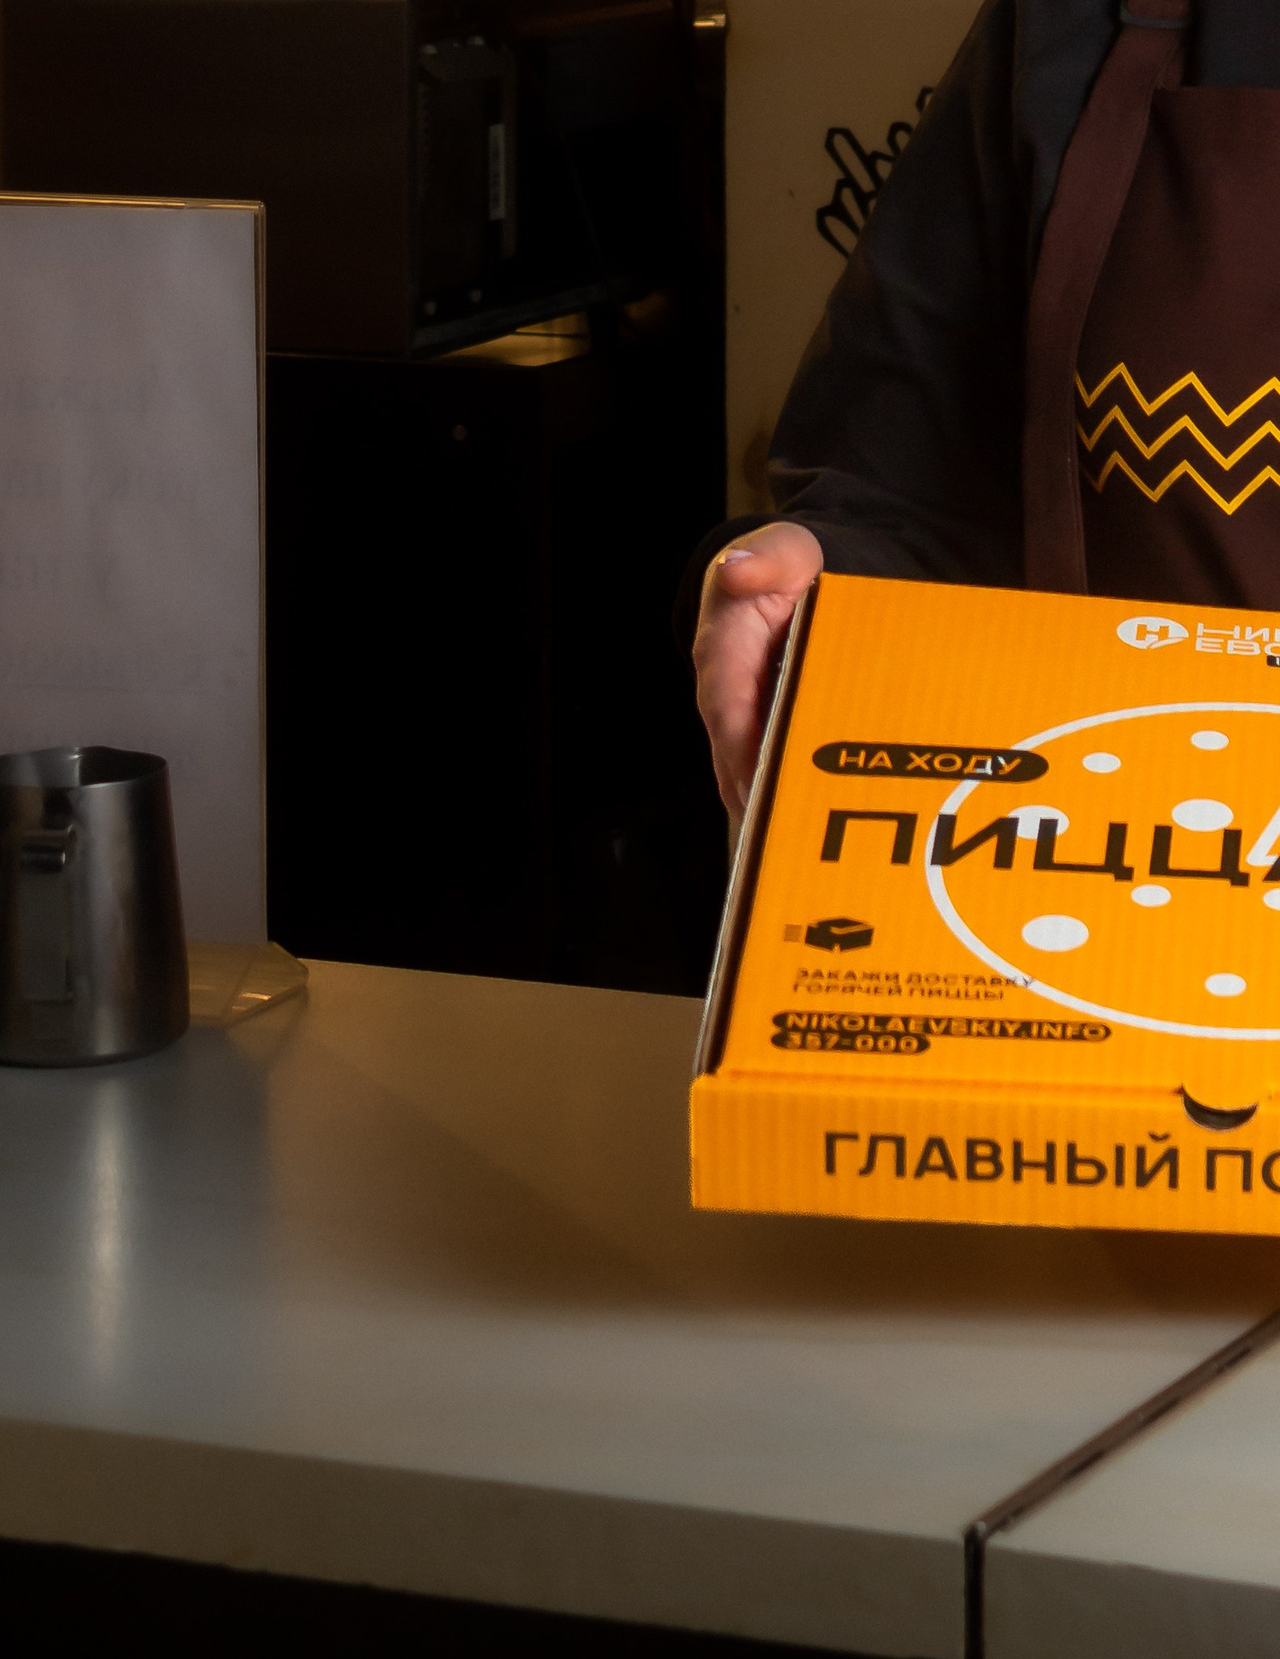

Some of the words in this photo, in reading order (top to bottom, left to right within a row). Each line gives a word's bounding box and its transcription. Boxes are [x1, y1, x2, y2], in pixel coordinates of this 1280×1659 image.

[837, 749, 892, 772] НА
[905, 750, 1023, 776] ХОДУ
[797, 967, 902, 985] ЗАКАЖИ
[908, 986, 1005, 1001] ПИЦЦЫ
[785, 1012, 1107, 1040] NIKOLAEVSKIY.INFO
[823, 1130, 1181, 1190] ГЛАВНЫЙ
